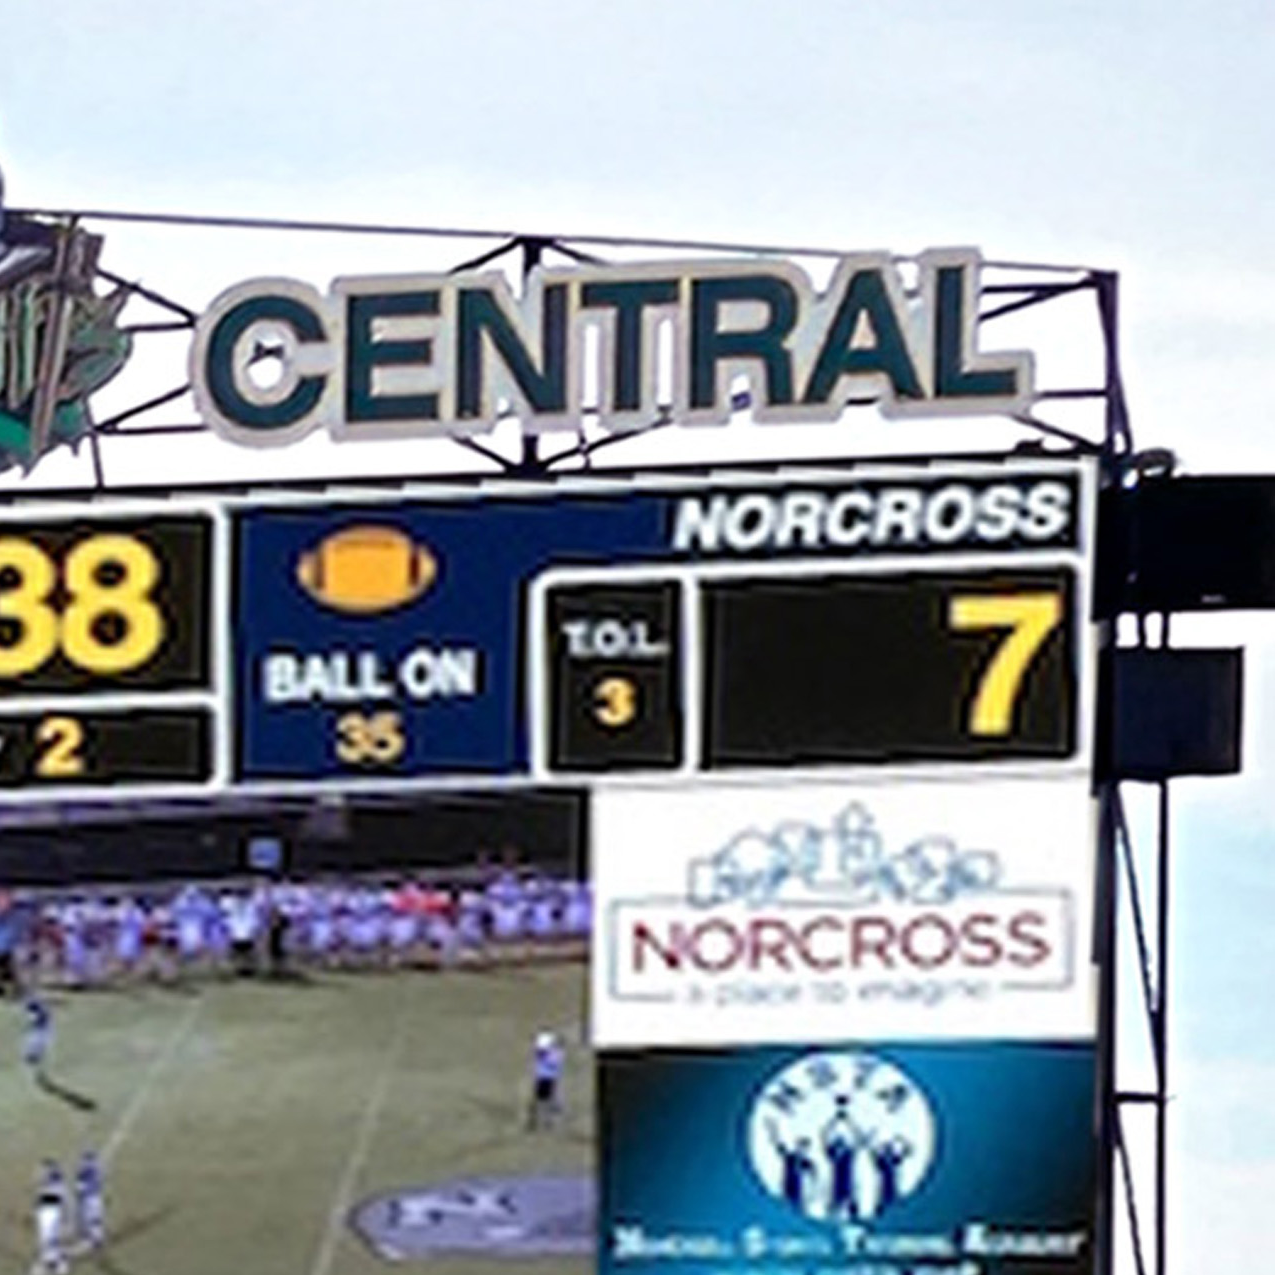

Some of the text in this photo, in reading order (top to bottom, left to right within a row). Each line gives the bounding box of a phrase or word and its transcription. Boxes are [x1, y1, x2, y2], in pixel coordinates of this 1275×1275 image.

[199, 258, 1025, 434] CENTRAL
[673, 484, 1070, 551] NORCROSS
[263, 649, 476, 701] BALL ON
[948, 592, 1064, 737] 7
[593, 677, 636, 727] 3
[35, 716, 85, 777] 2
[335, 714, 403, 765] 35
[631, 912, 1053, 975] NORCROSS
